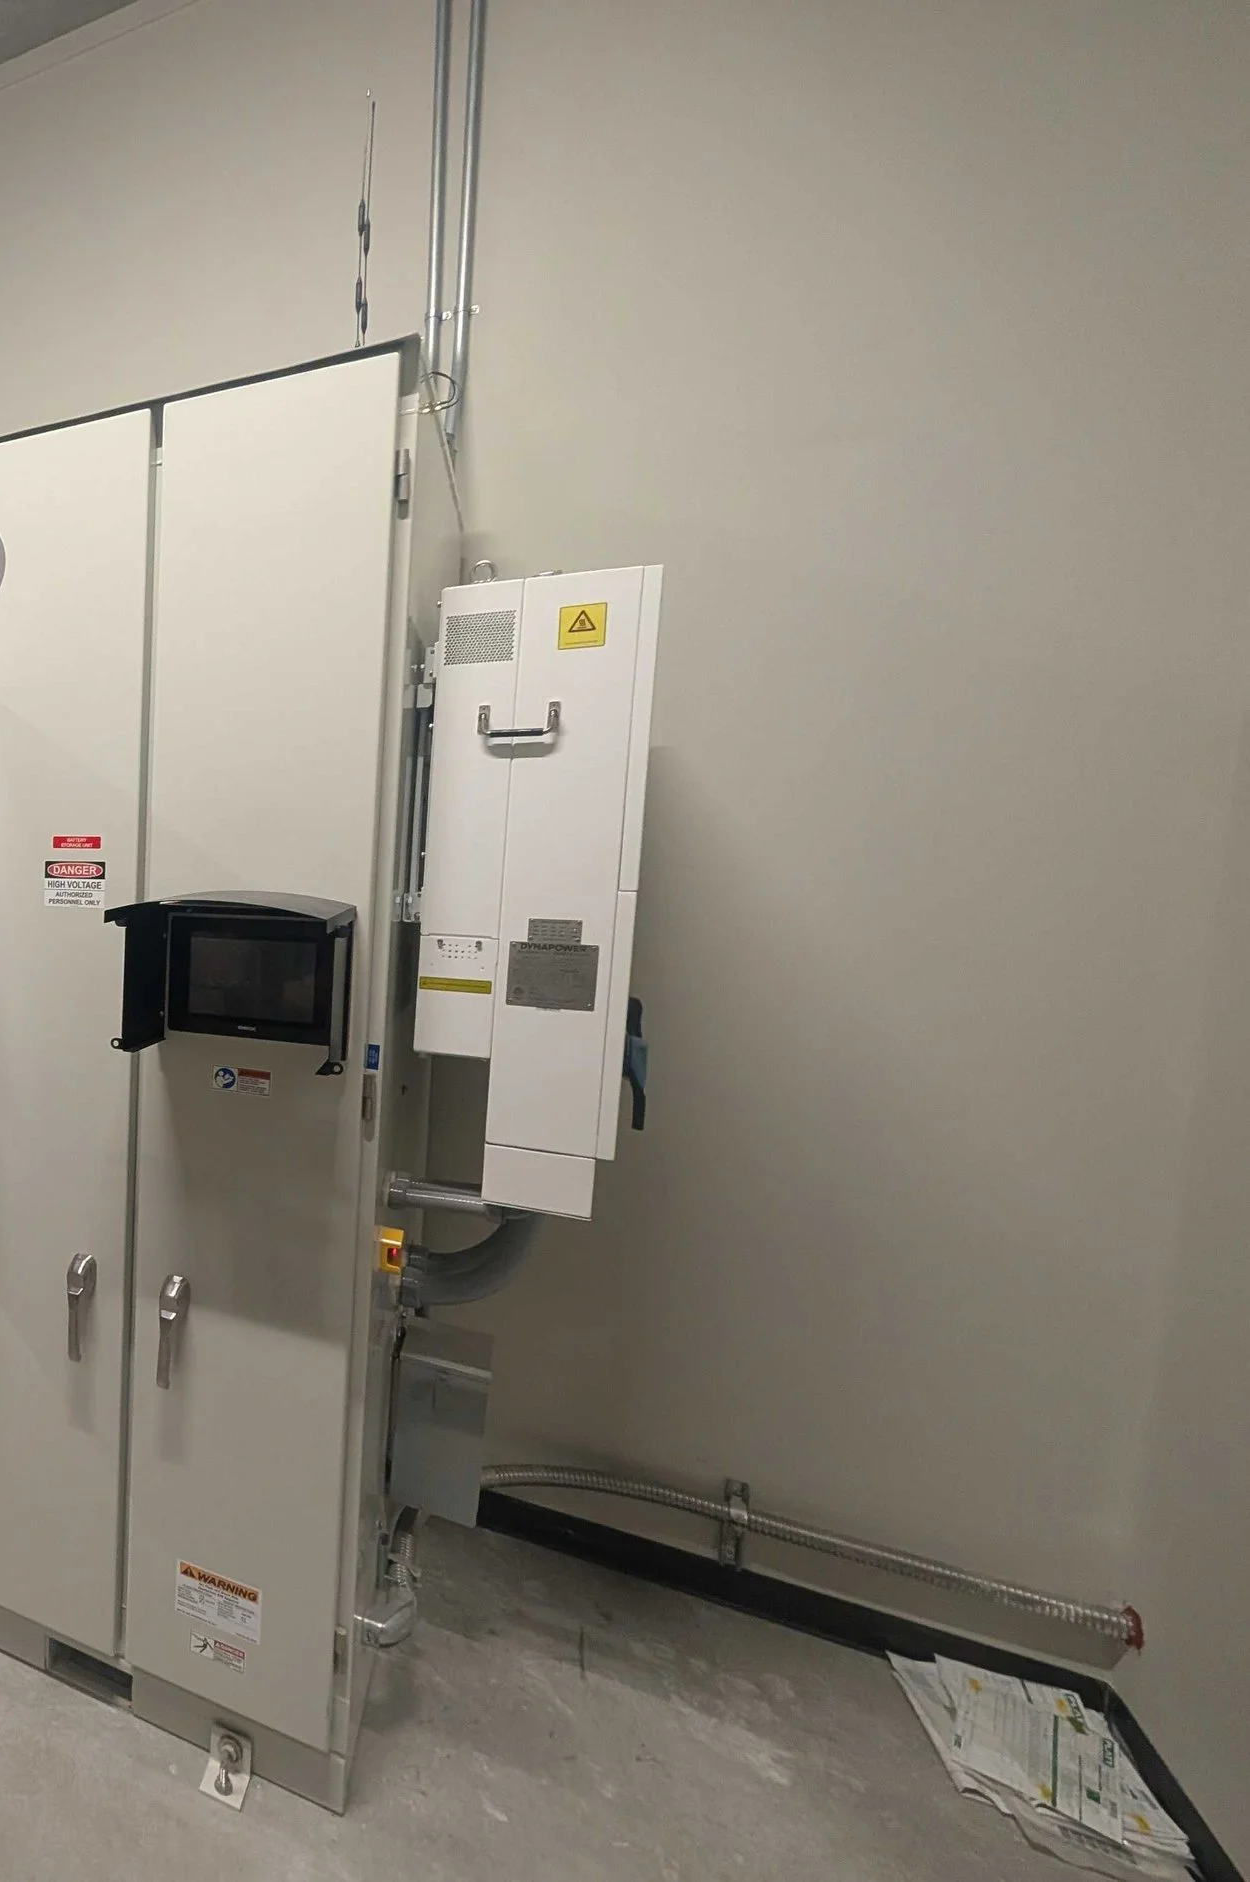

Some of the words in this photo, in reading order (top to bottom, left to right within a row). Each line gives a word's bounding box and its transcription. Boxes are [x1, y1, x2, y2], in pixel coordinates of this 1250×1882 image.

[53, 865, 97, 875] DANGER
[47, 880, 66, 888] HIGH
[67, 880, 102, 890] VOLTAGE
[520, 943, 587, 952] DYNAPOWER
[197, 1571, 259, 1603] WARNING
